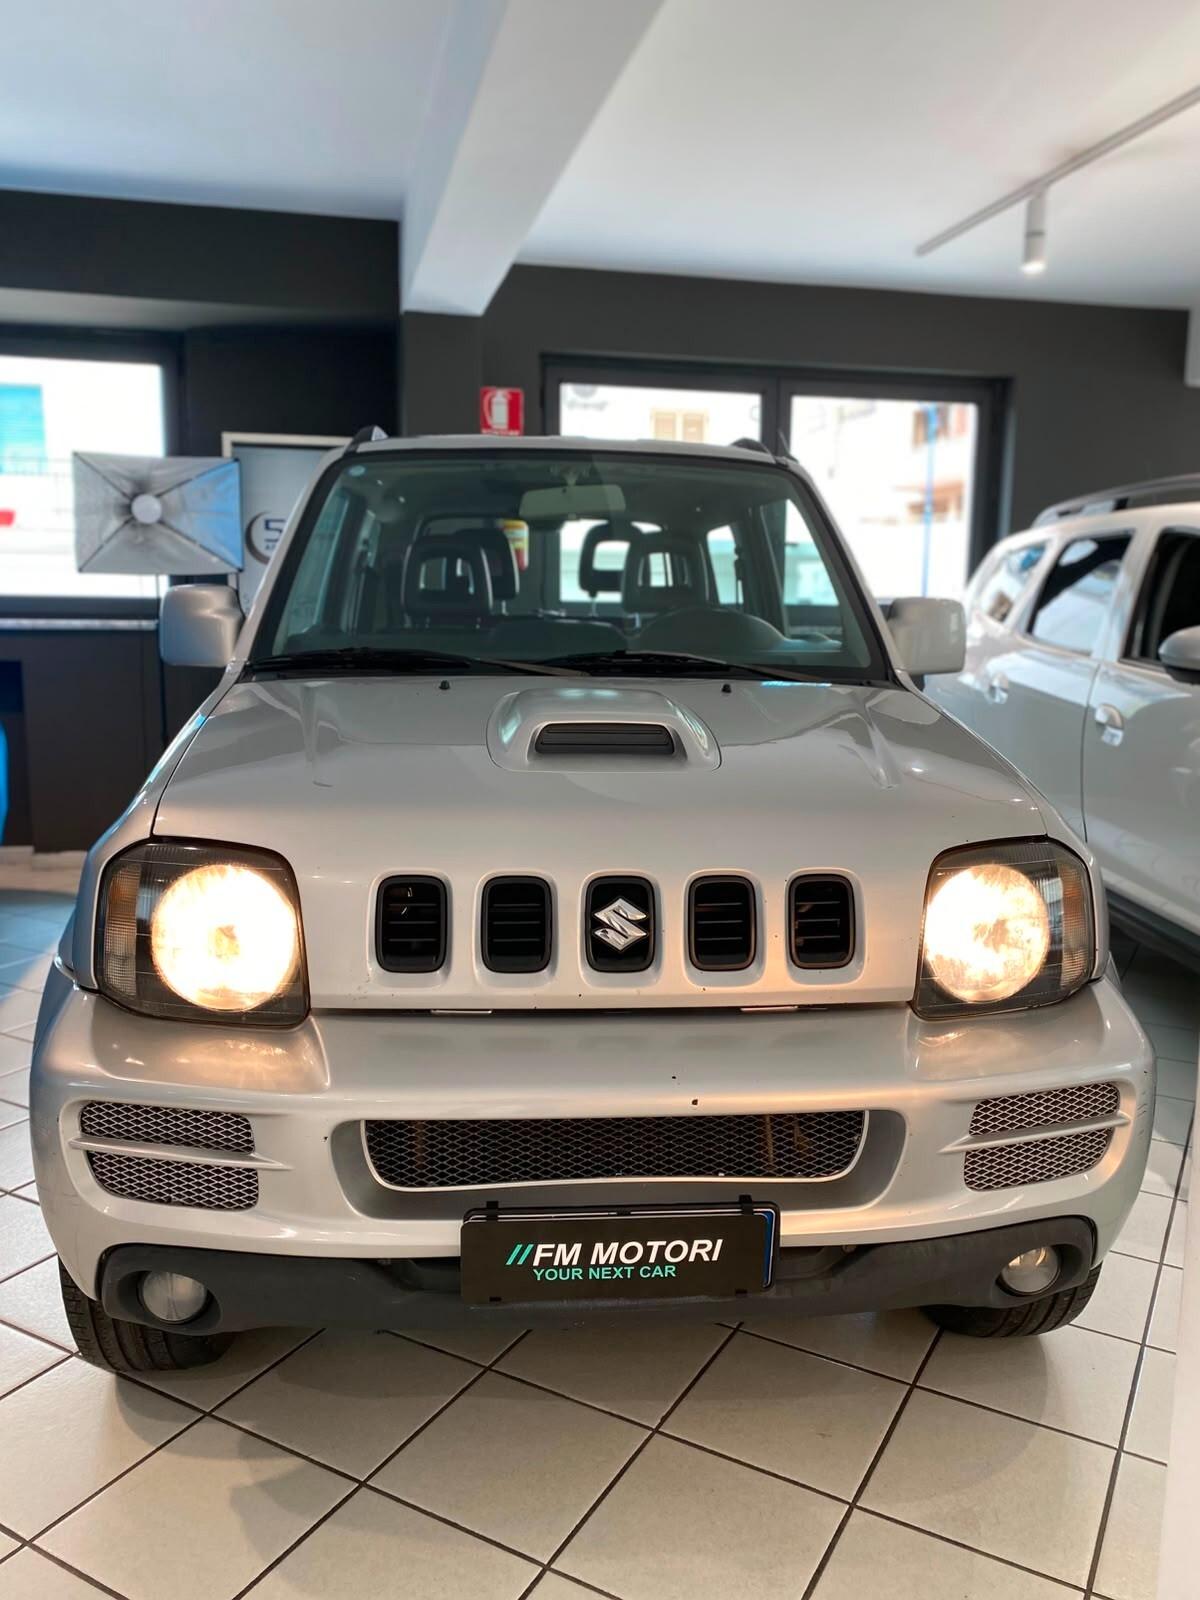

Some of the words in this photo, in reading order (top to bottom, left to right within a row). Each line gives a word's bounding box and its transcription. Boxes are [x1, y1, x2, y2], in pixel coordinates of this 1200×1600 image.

[590, 1239, 723, 1265] MOTORI
[533, 1268, 583, 1281] YOUR
[588, 1266, 634, 1280] NEXT
[639, 1265, 676, 1278] CAR
